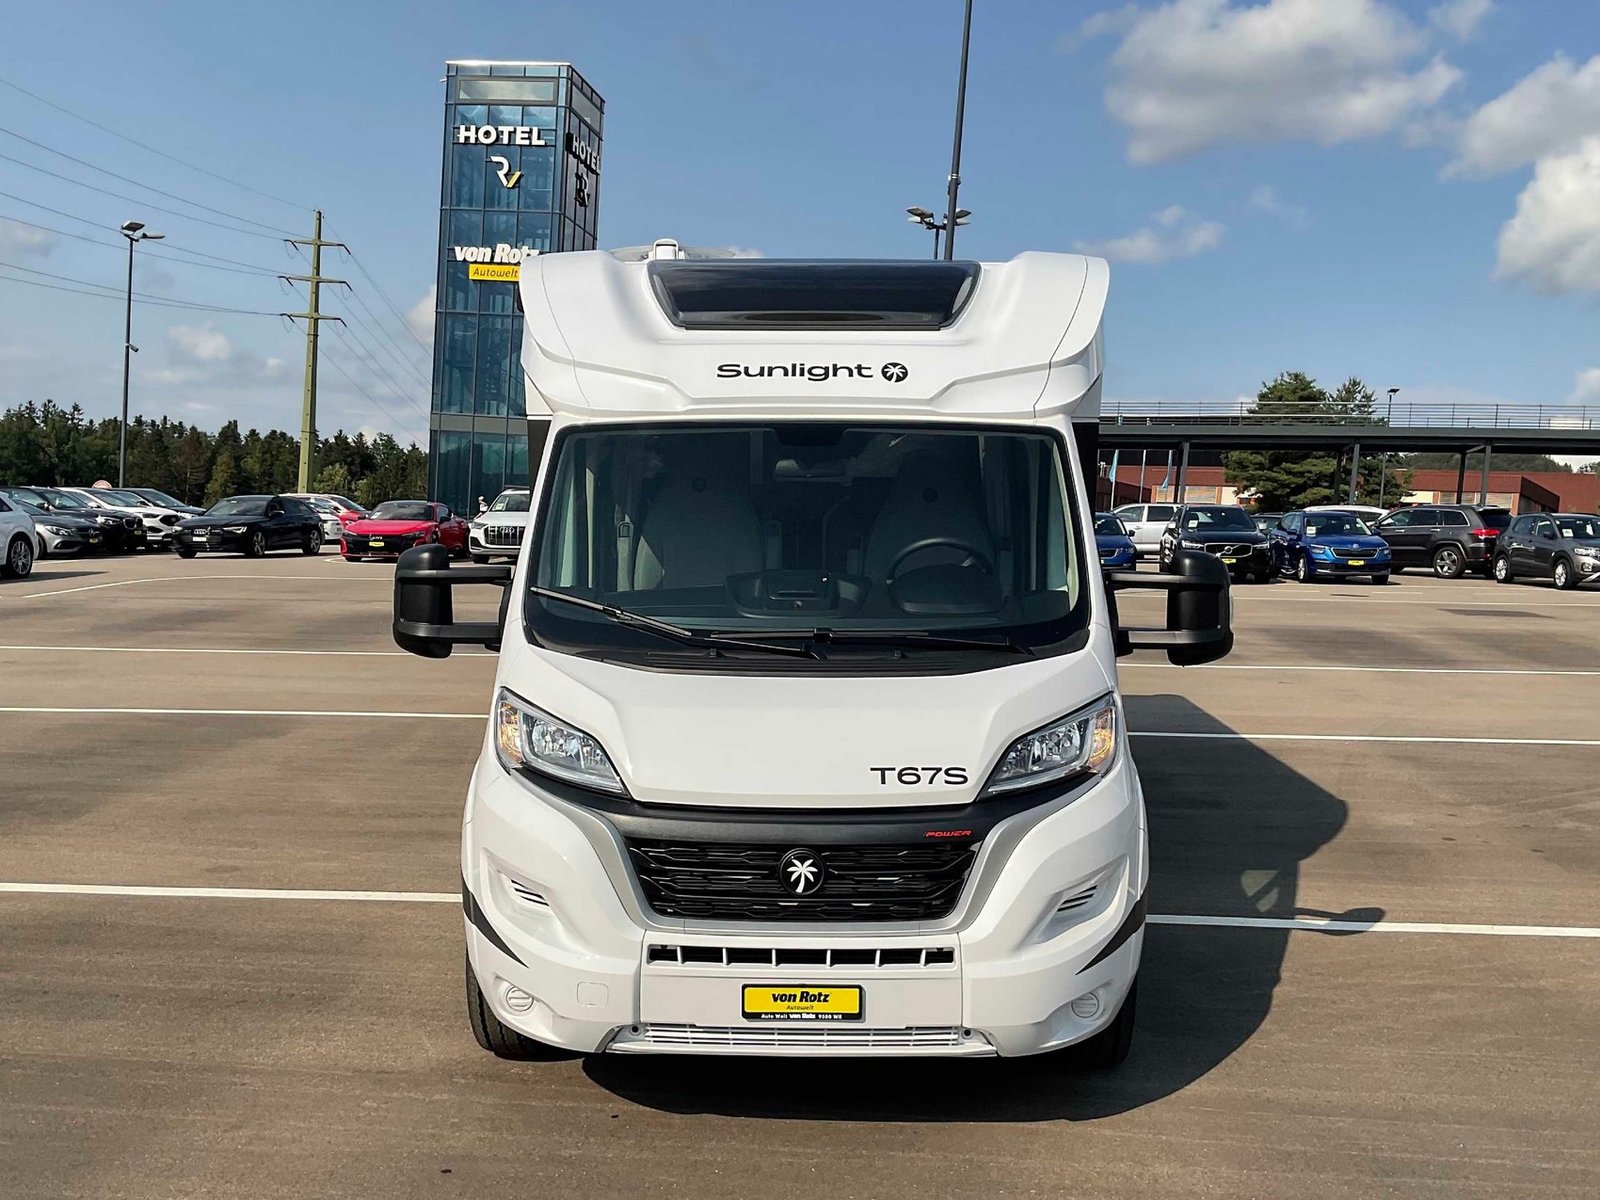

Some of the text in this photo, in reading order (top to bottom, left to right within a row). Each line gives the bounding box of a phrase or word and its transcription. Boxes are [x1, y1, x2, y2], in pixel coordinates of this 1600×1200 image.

[458, 124, 546, 146] HOTEL
[454, 245, 493, 263] von
[472, 267, 519, 279] Autowelt
[716, 362, 874, 382] Sunlight
[870, 766, 968, 785] T67S
[925, 829, 972, 838] POWER
[771, 990, 830, 1003] von Rotz
